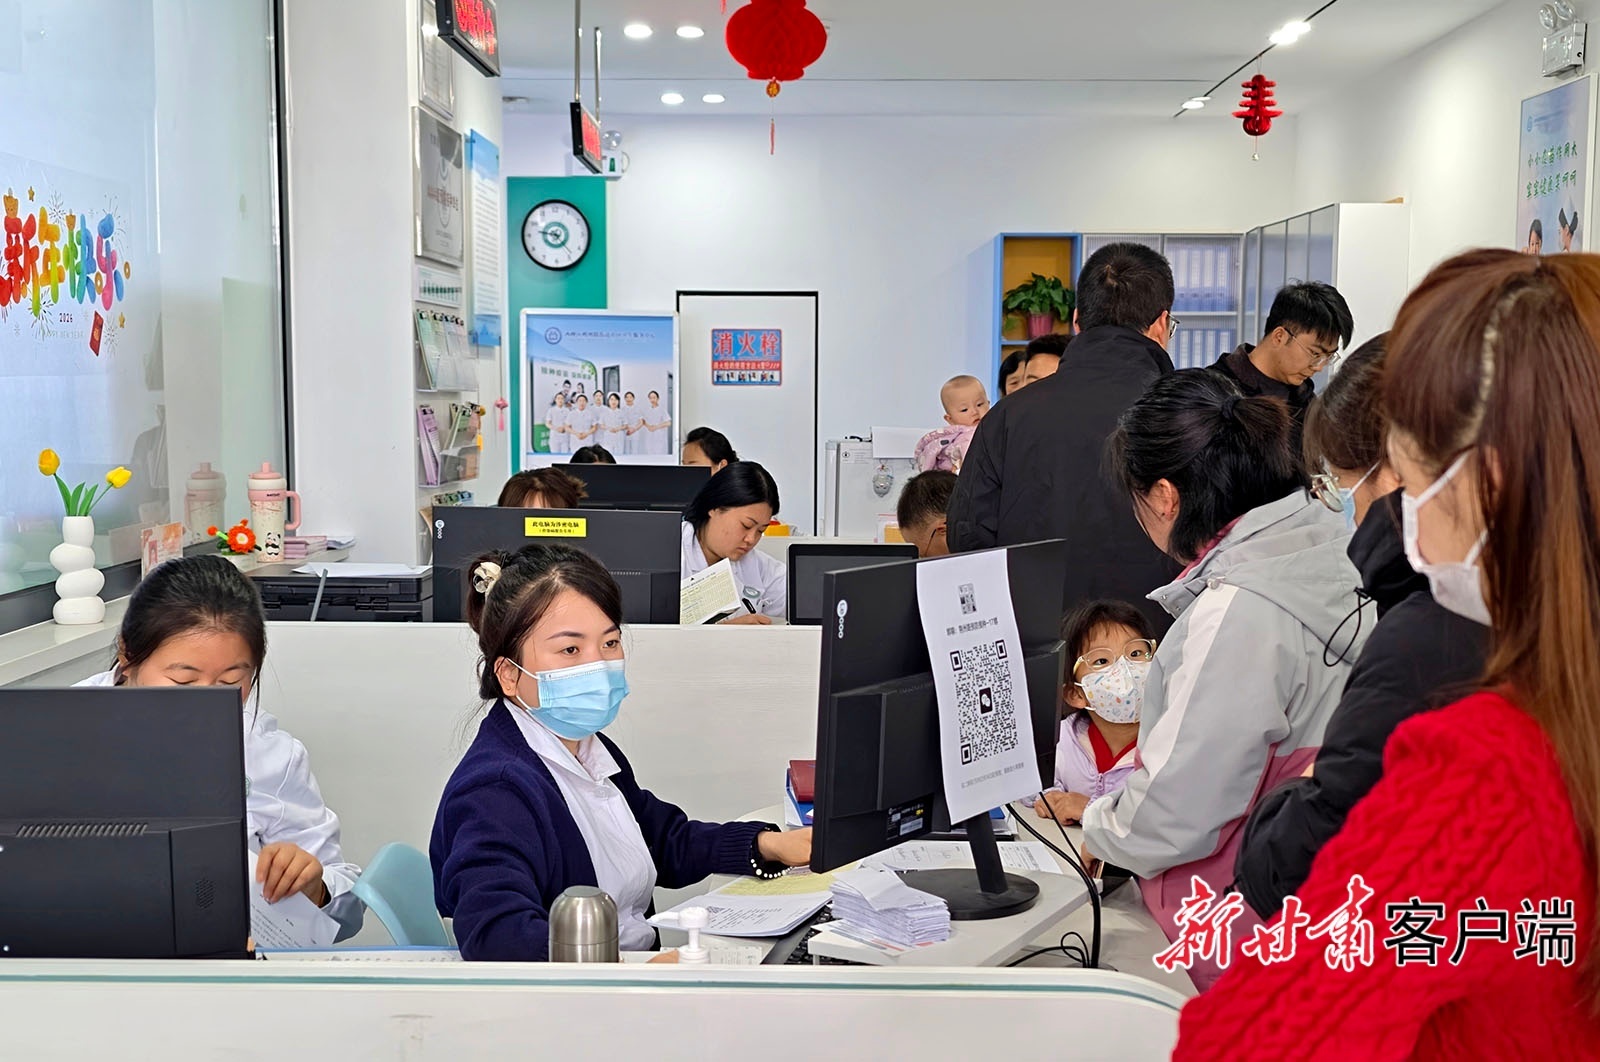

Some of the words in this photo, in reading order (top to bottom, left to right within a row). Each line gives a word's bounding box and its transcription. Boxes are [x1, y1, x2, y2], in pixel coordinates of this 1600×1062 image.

[0, 194, 124, 317] 新年快乐
[60, 313, 72, 322] 2026
[714, 332, 778, 356] 消火栓
